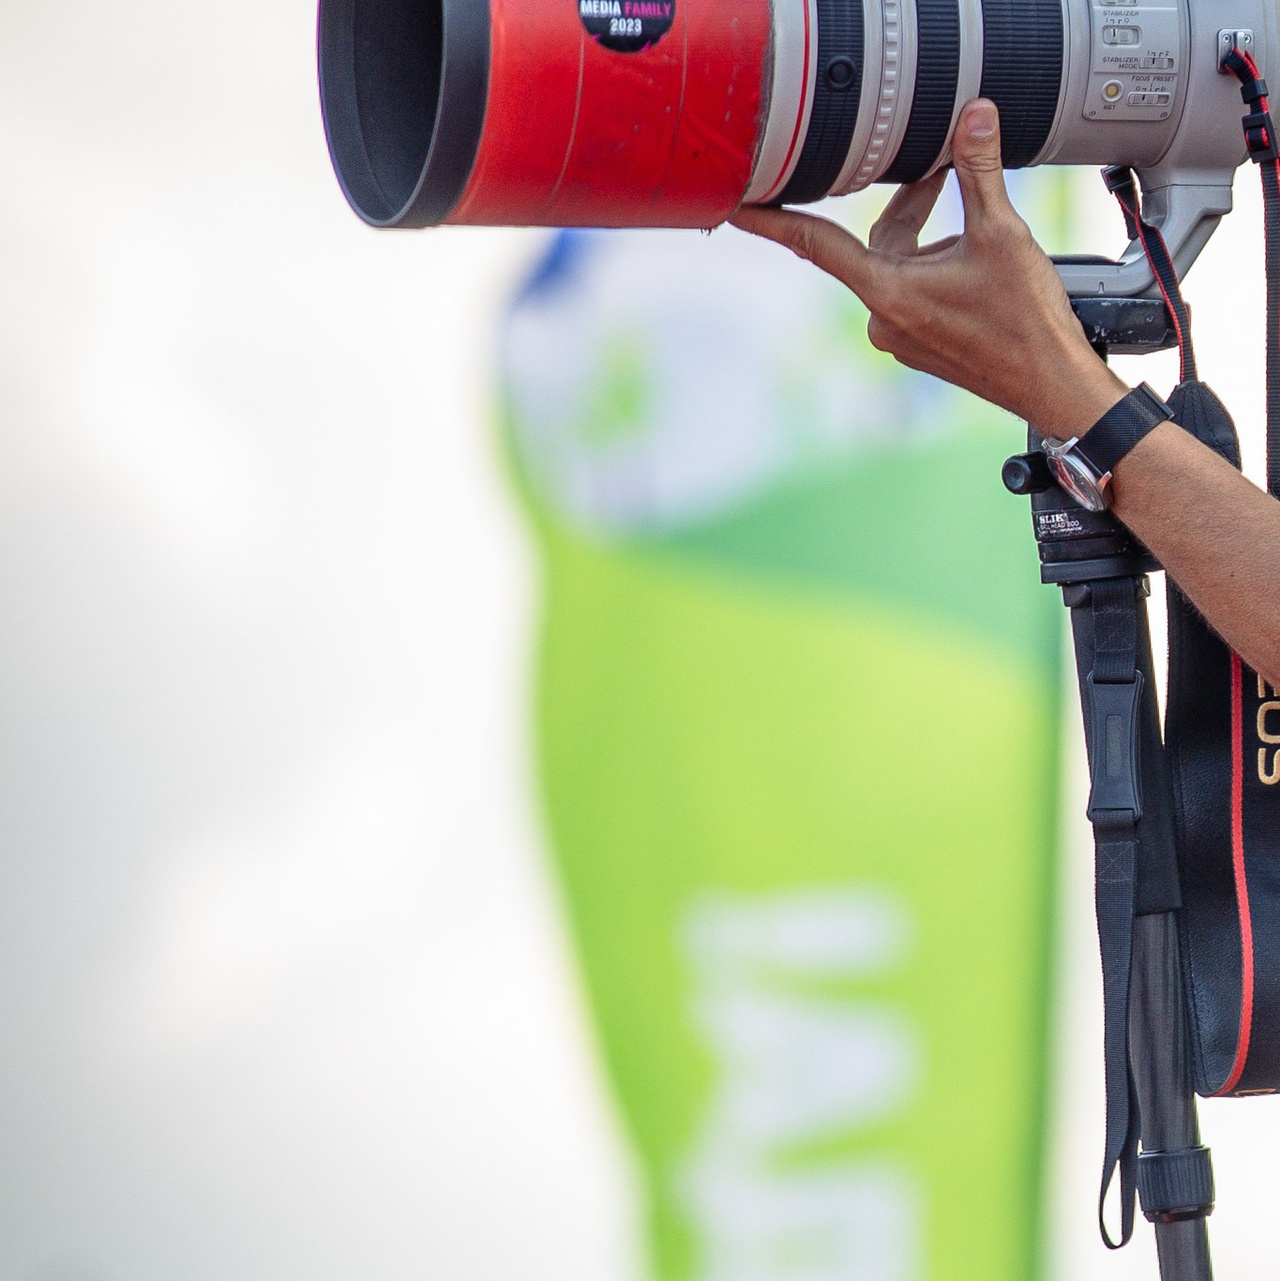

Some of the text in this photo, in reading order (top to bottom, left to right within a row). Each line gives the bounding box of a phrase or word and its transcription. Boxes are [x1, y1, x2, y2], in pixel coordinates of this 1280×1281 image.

[624, 1, 672, 18] FAMILY
[1102, 9, 1140, 17] STABILIZER
[609, 18, 643, 36] 2023
[1039, 513, 1065, 524] SLIK
